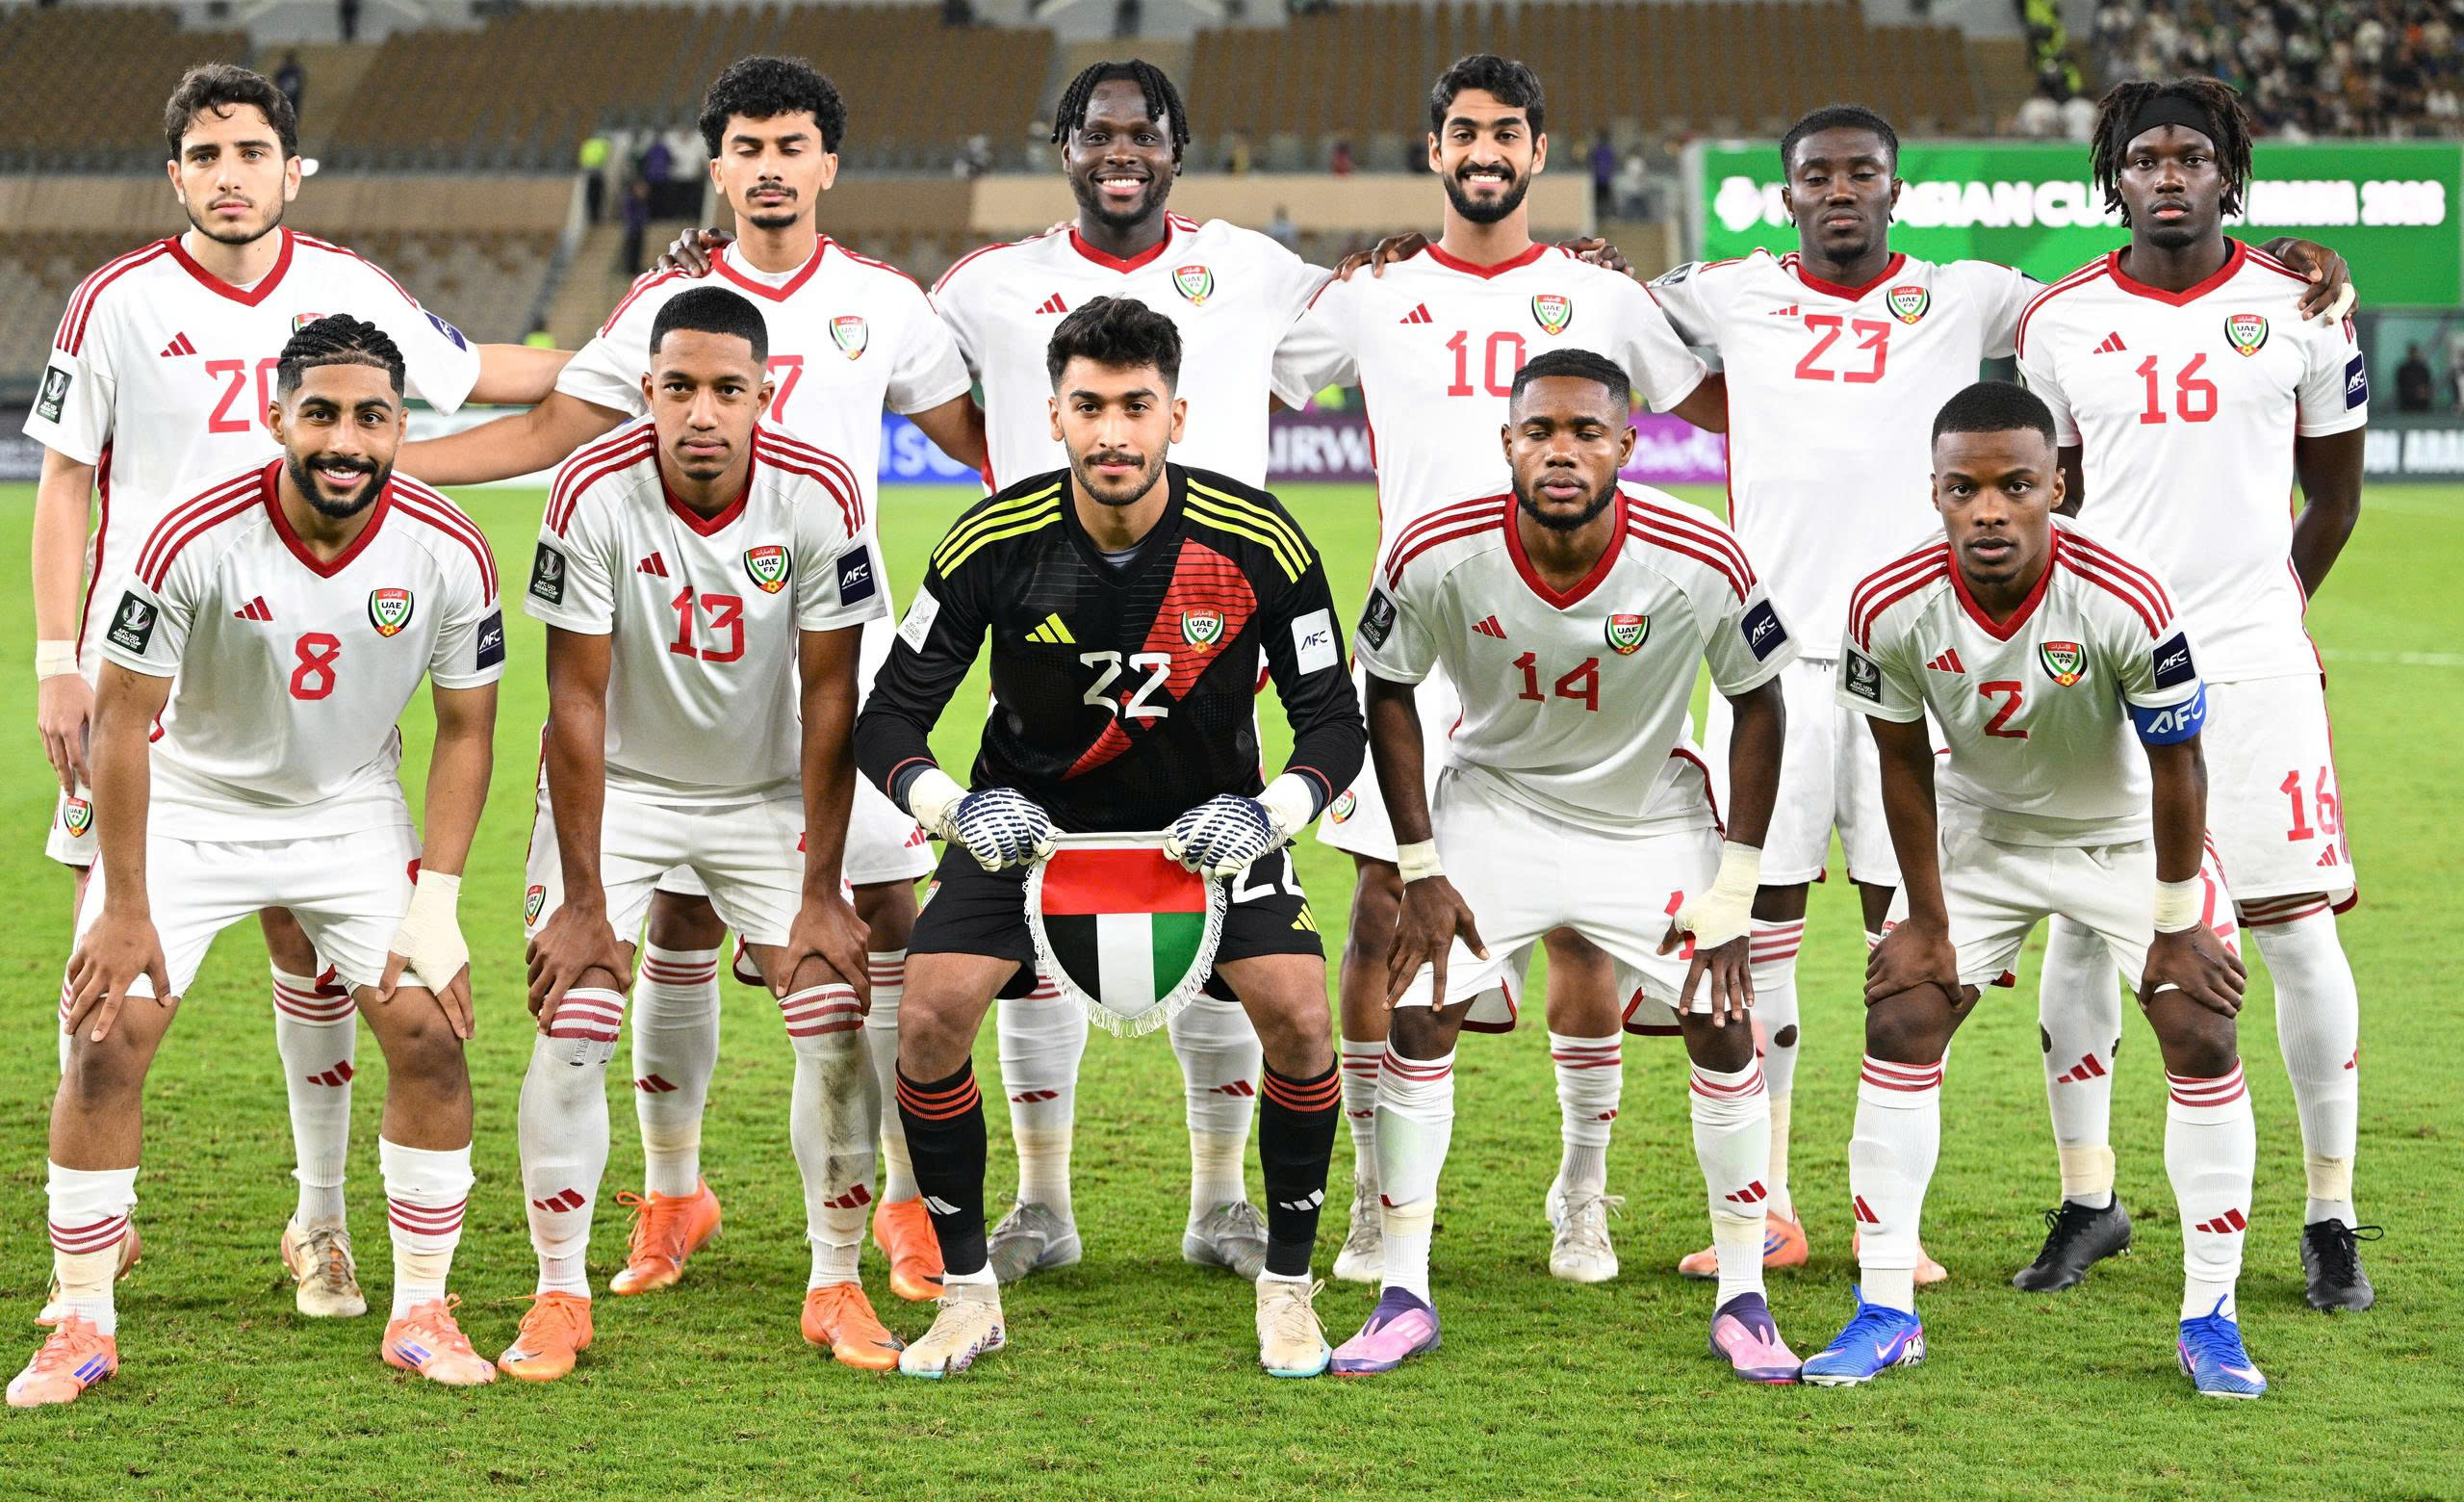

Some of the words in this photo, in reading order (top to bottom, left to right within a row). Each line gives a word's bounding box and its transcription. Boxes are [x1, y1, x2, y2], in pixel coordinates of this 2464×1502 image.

[1446, 330, 1527, 398] 10
[1794, 314, 1891, 384] 23
[767, 354, 804, 425] 7
[2135, 352, 2218, 425] 16
[757, 557, 779, 567] UAE
[841, 562, 869, 586] AFC
[478, 628, 501, 651] AFC
[670, 585, 745, 663] 13
[1192, 619, 1214, 628] UAE
[1301, 630, 1328, 651] AFC
[1617, 626, 1638, 634] UAE
[1752, 614, 1776, 645] AFC
[290, 632, 342, 700] 8
[1079, 650, 1171, 719] 22
[1512, 651, 1600, 712] 14
[2156, 648, 2188, 673] AFC
[1979, 680, 2029, 739] 2
[2146, 691, 2203, 734] AFC
[2279, 765, 2336, 842] 16
